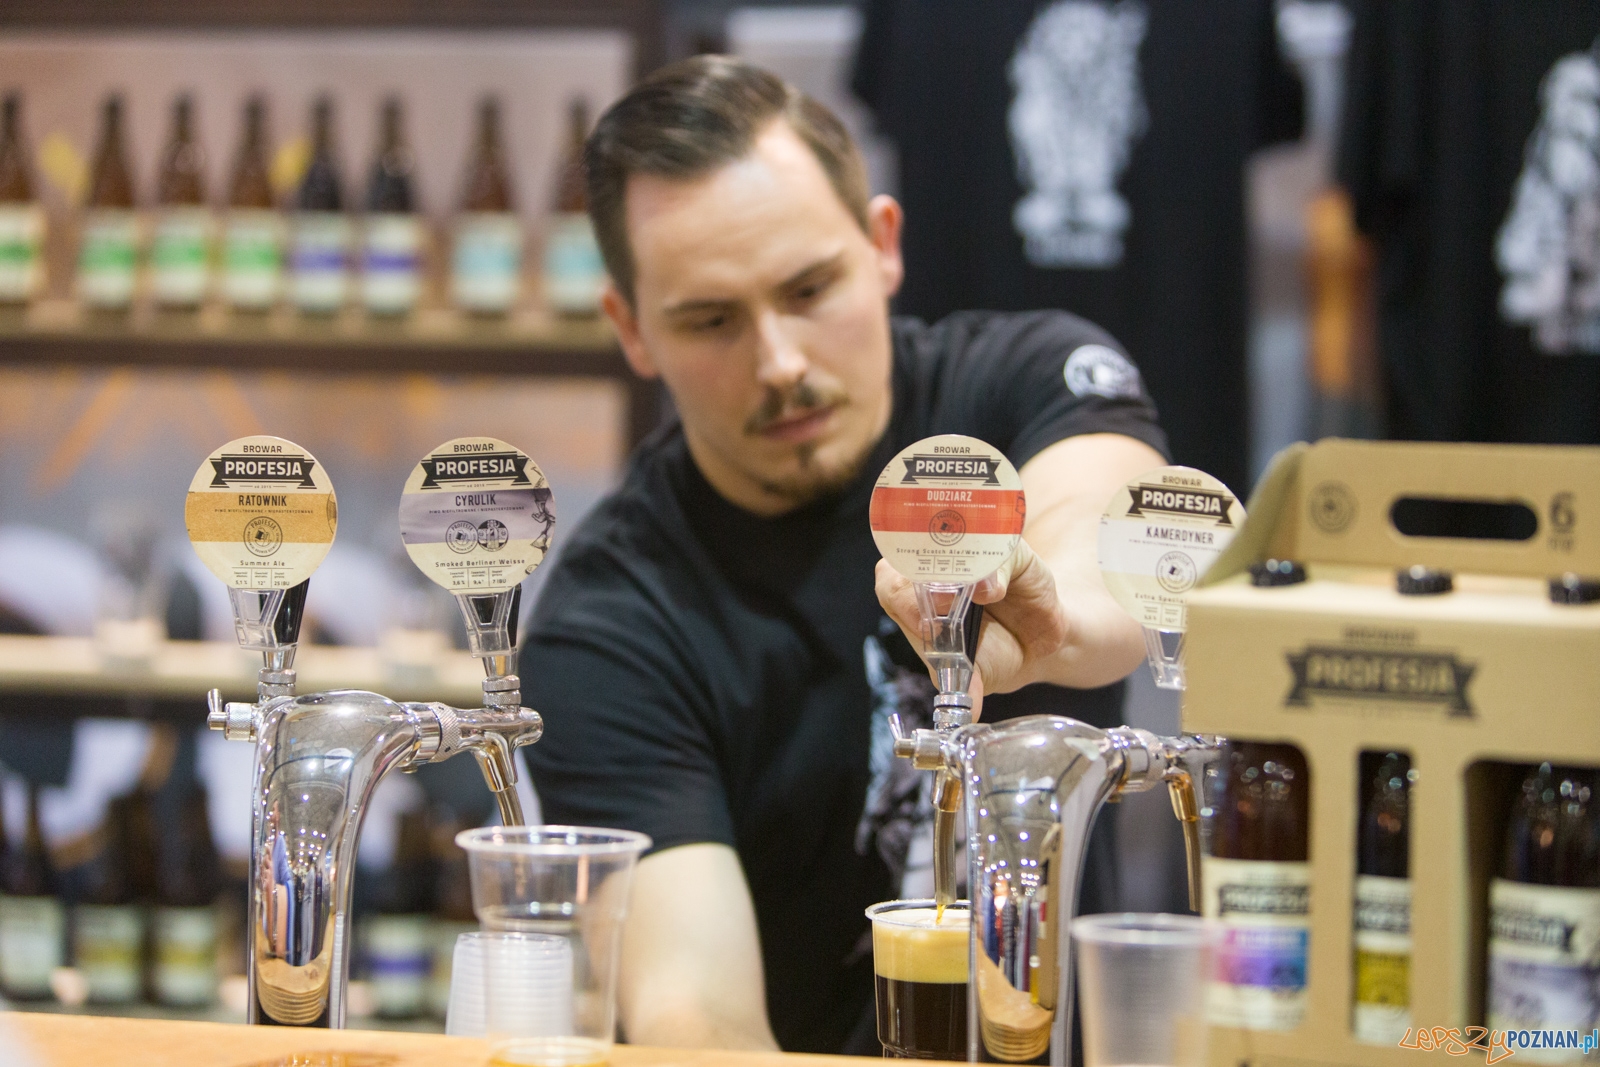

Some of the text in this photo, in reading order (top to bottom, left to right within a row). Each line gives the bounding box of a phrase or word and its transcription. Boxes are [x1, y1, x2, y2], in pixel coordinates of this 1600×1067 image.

[243, 445, 282, 453] BROWAR
[454, 443, 494, 453] BROWAR
[934, 446, 970, 454] BROWAR
[225, 461, 303, 476] PROFESJA
[436, 458, 516, 476] PROFESJA
[916, 460, 988, 474] PROFESJA
[1162, 476, 1202, 486] BROWAR
[239, 495, 287, 506] RATOWNIK
[455, 494, 496, 506] CYRULIK
[927, 490, 972, 502] DUDZIARZ
[1142, 490, 1221, 513] PROFESJA
[1550, 491, 1576, 532] 6
[250, 519, 277, 530] PROFESJA
[1146, 526, 1214, 544] KAMERDYNER
[1306, 655, 1455, 694] PROFESJA
